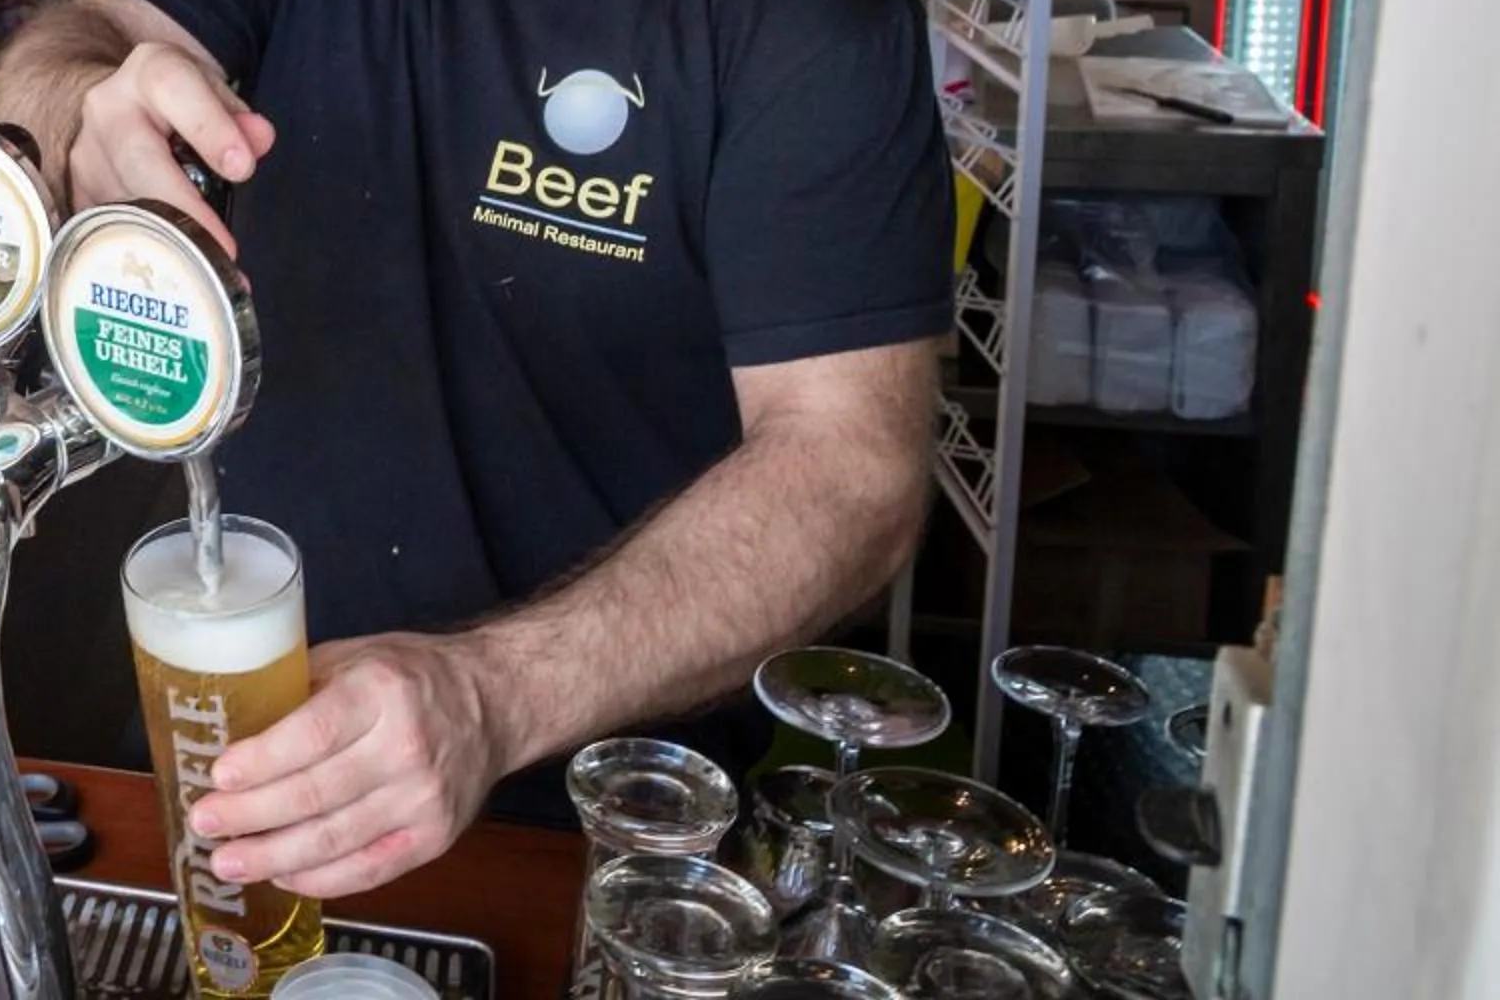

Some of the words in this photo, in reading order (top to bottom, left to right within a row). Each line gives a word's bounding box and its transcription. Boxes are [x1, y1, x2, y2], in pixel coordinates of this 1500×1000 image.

[486, 139, 654, 226] Beef
[473, 205, 539, 238] Minimal
[543, 224, 645, 264] Restaurant
[90, 282, 190, 329] RIEGELE
[94, 338, 189, 385] URHELL
[97, 317, 184, 361] FEINES
[167, 683, 247, 918] RELE
